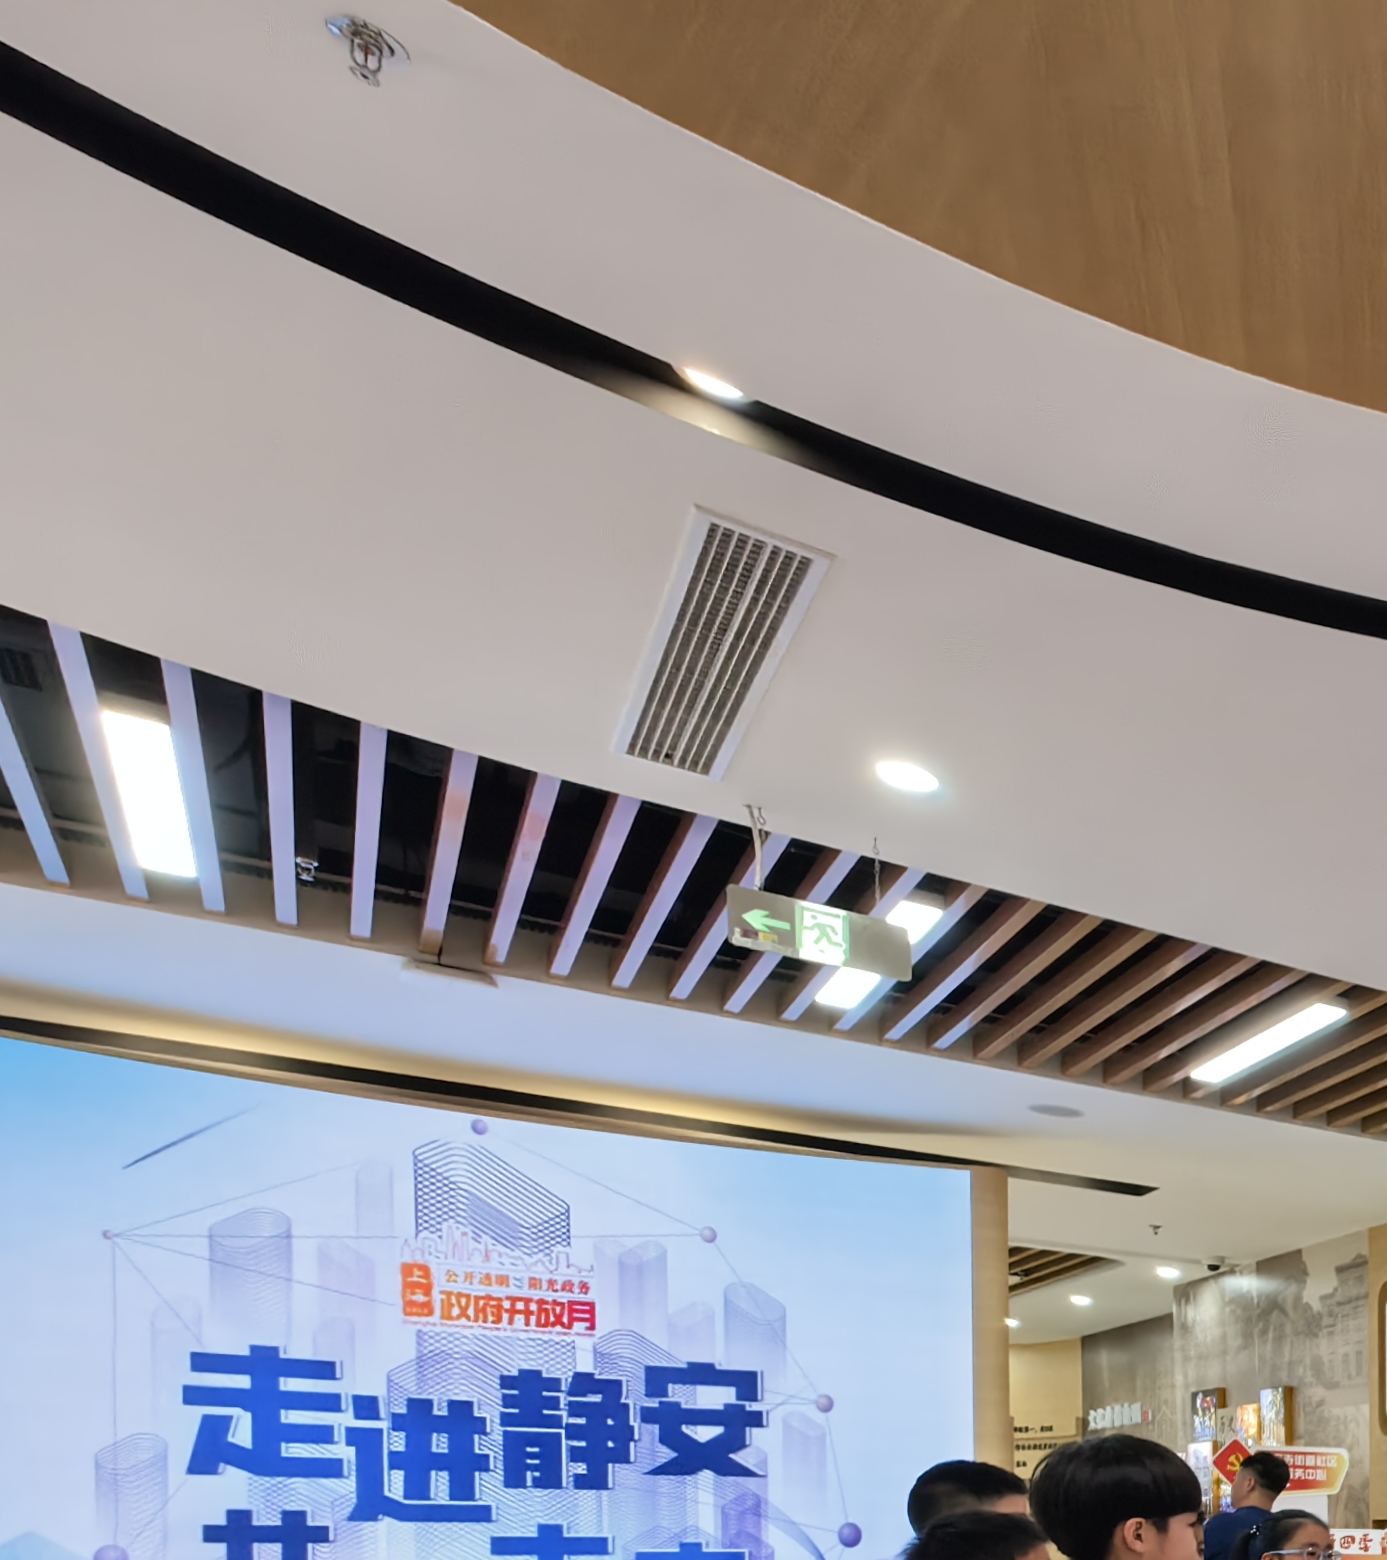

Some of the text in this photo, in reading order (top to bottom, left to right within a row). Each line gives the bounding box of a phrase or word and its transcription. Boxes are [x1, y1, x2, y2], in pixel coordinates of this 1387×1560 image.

[445, 1269, 510, 1288] 公开透明
[438, 1289, 597, 1331] 政府开放月
[182, 1344, 768, 1522] 走进静安
[1274, 1453, 1338, 1468] 寺街道社区
[1290, 1468, 1327, 1481] 务中心
